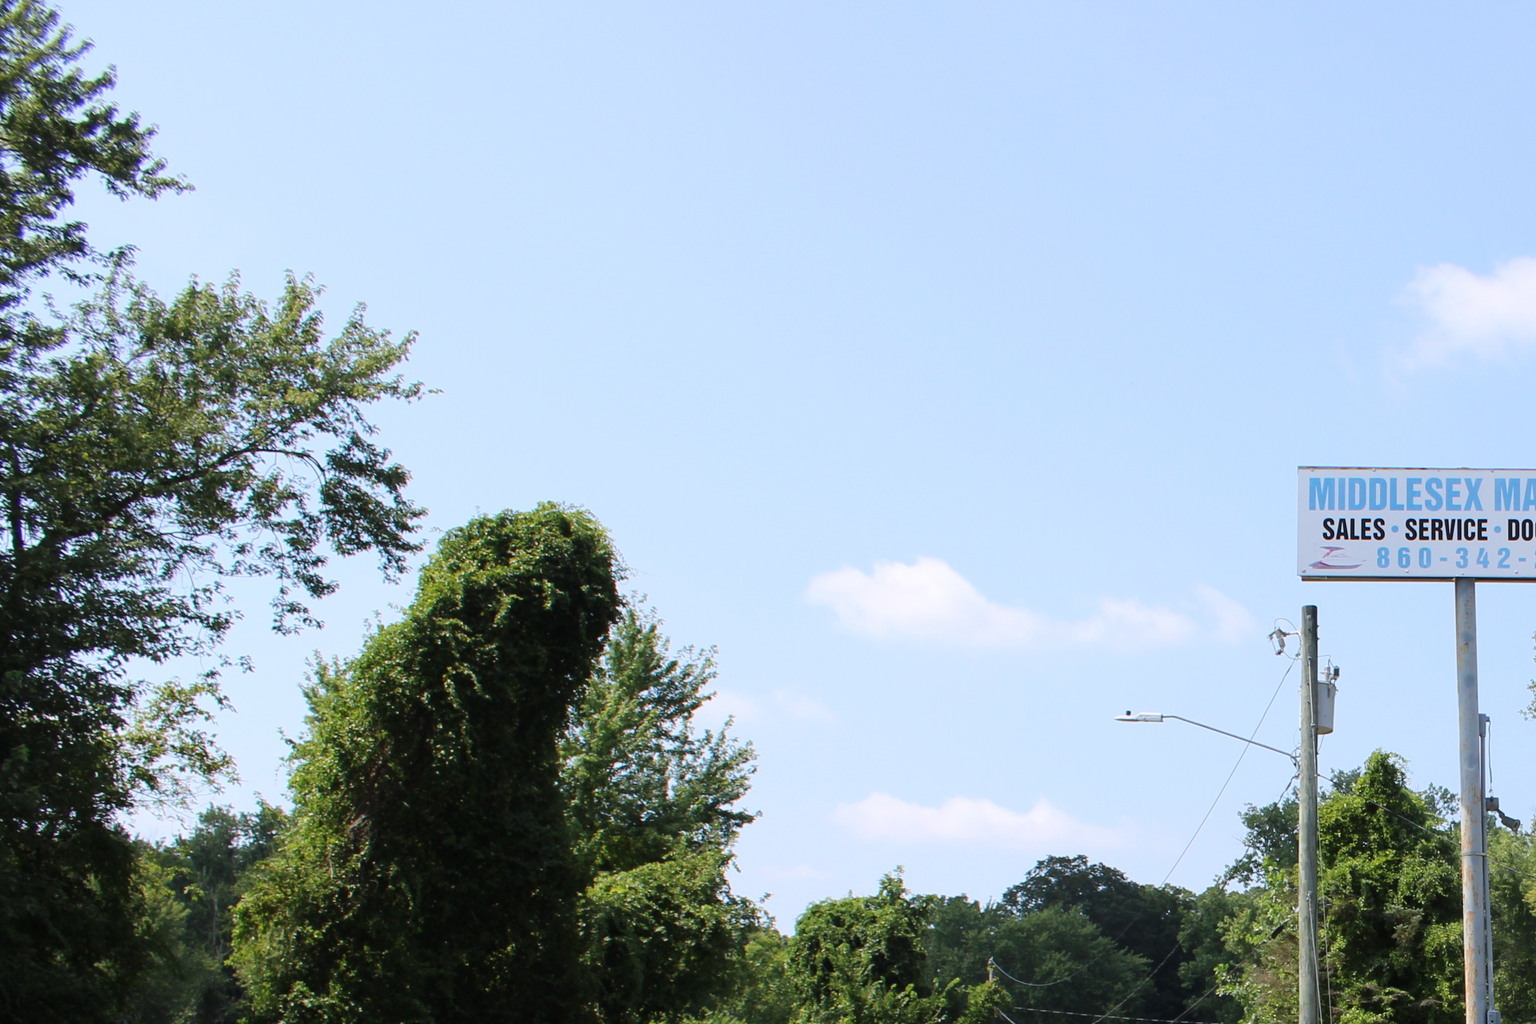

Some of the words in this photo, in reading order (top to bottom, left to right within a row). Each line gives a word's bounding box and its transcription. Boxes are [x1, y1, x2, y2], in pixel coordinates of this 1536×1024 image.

[1308, 477, 1484, 512] MIDDLESEX
[1322, 518, 1386, 541] SALES
[1405, 518, 1488, 541] SERVICE
